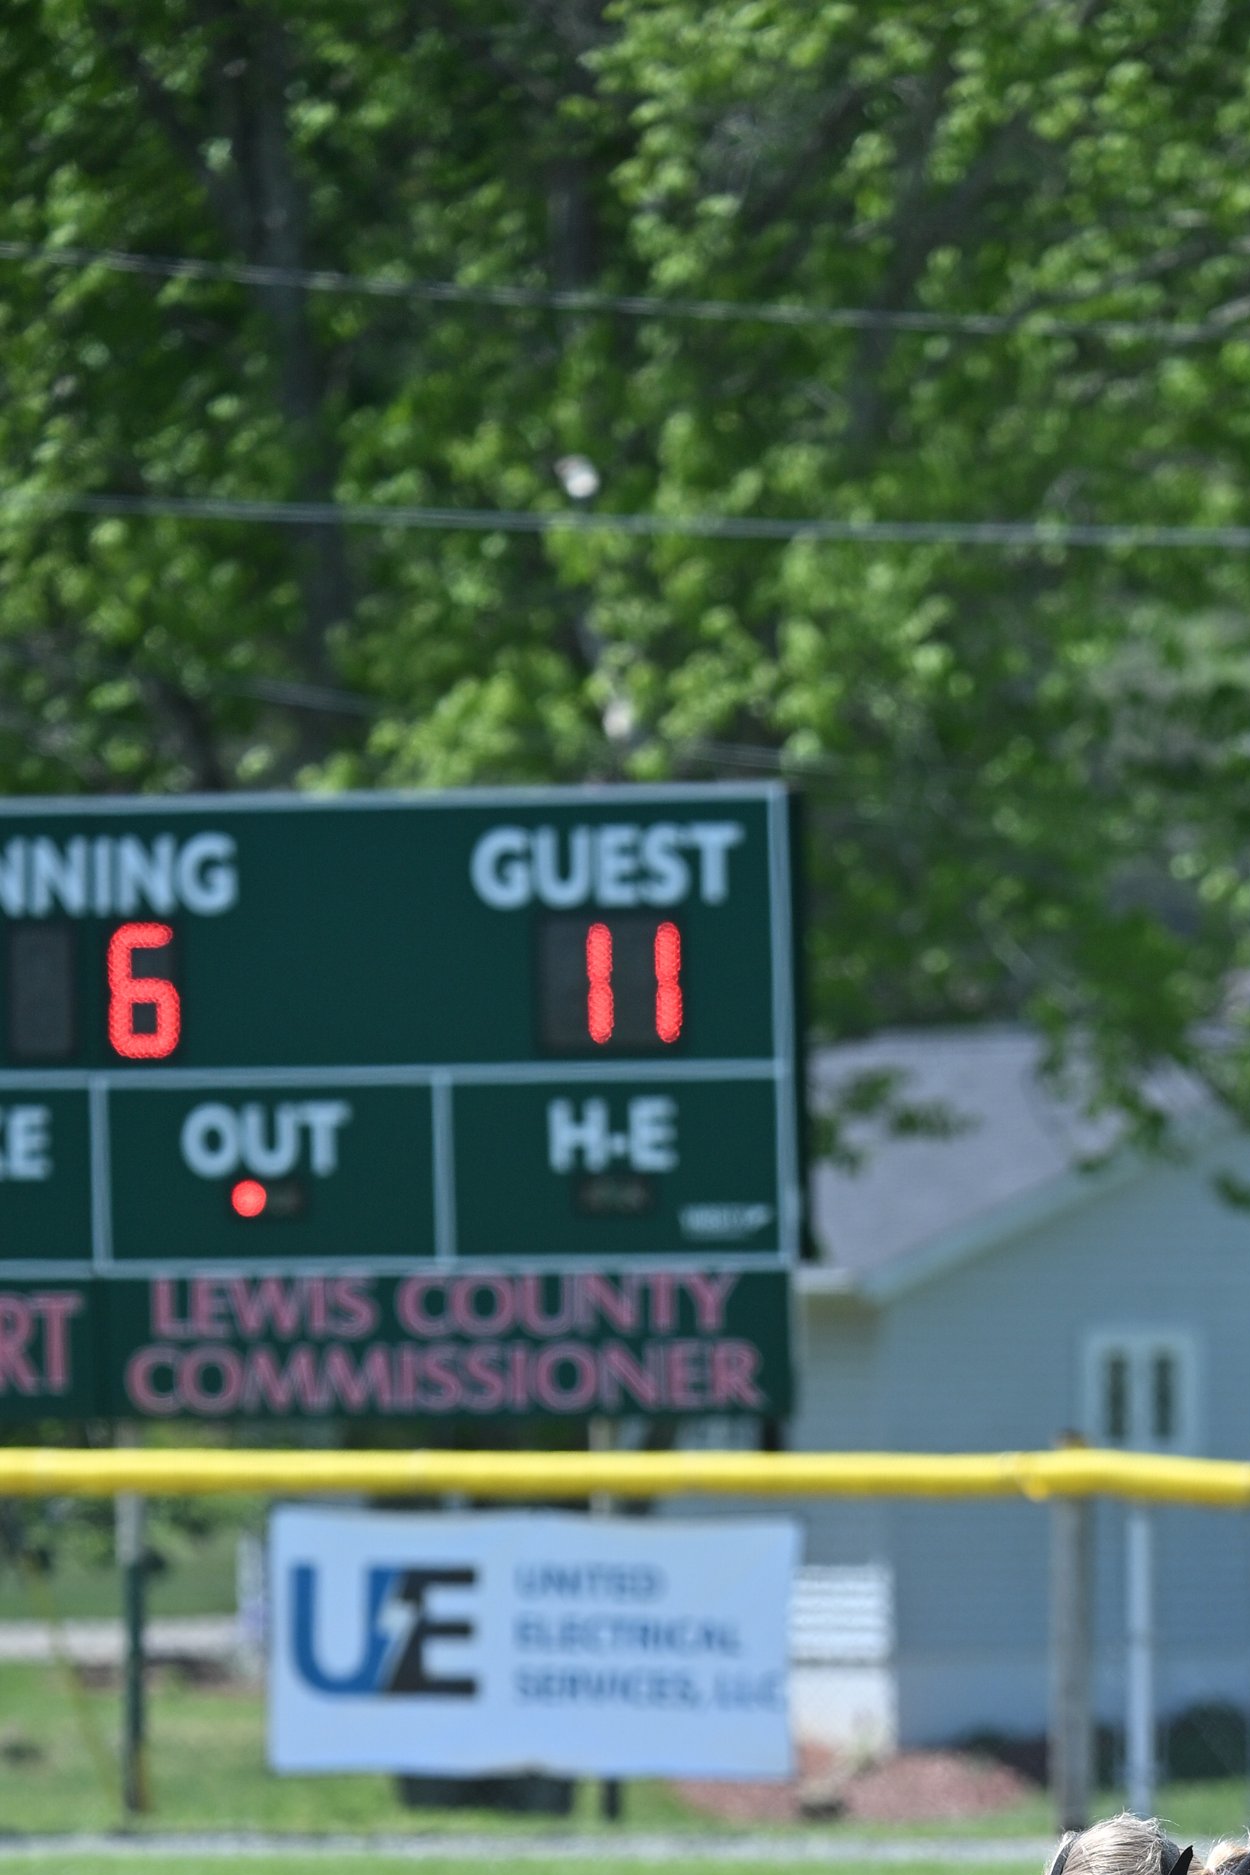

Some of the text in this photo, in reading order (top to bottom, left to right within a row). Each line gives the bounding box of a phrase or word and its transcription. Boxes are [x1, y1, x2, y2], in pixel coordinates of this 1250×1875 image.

[469, 820, 744, 909] GUEST
[107, 921, 181, 1059] 6
[585, 921, 684, 1044] 11
[0, 1104, 53, 1182] E
[180, 1101, 350, 1179] OUT
[150, 1271, 740, 1339] LEWIS COUNTY
[126, 1340, 766, 1416] COMMISSIONER
[512, 1563, 667, 1601] UNITED
[512, 1613, 741, 1658] ELECTRICAL
